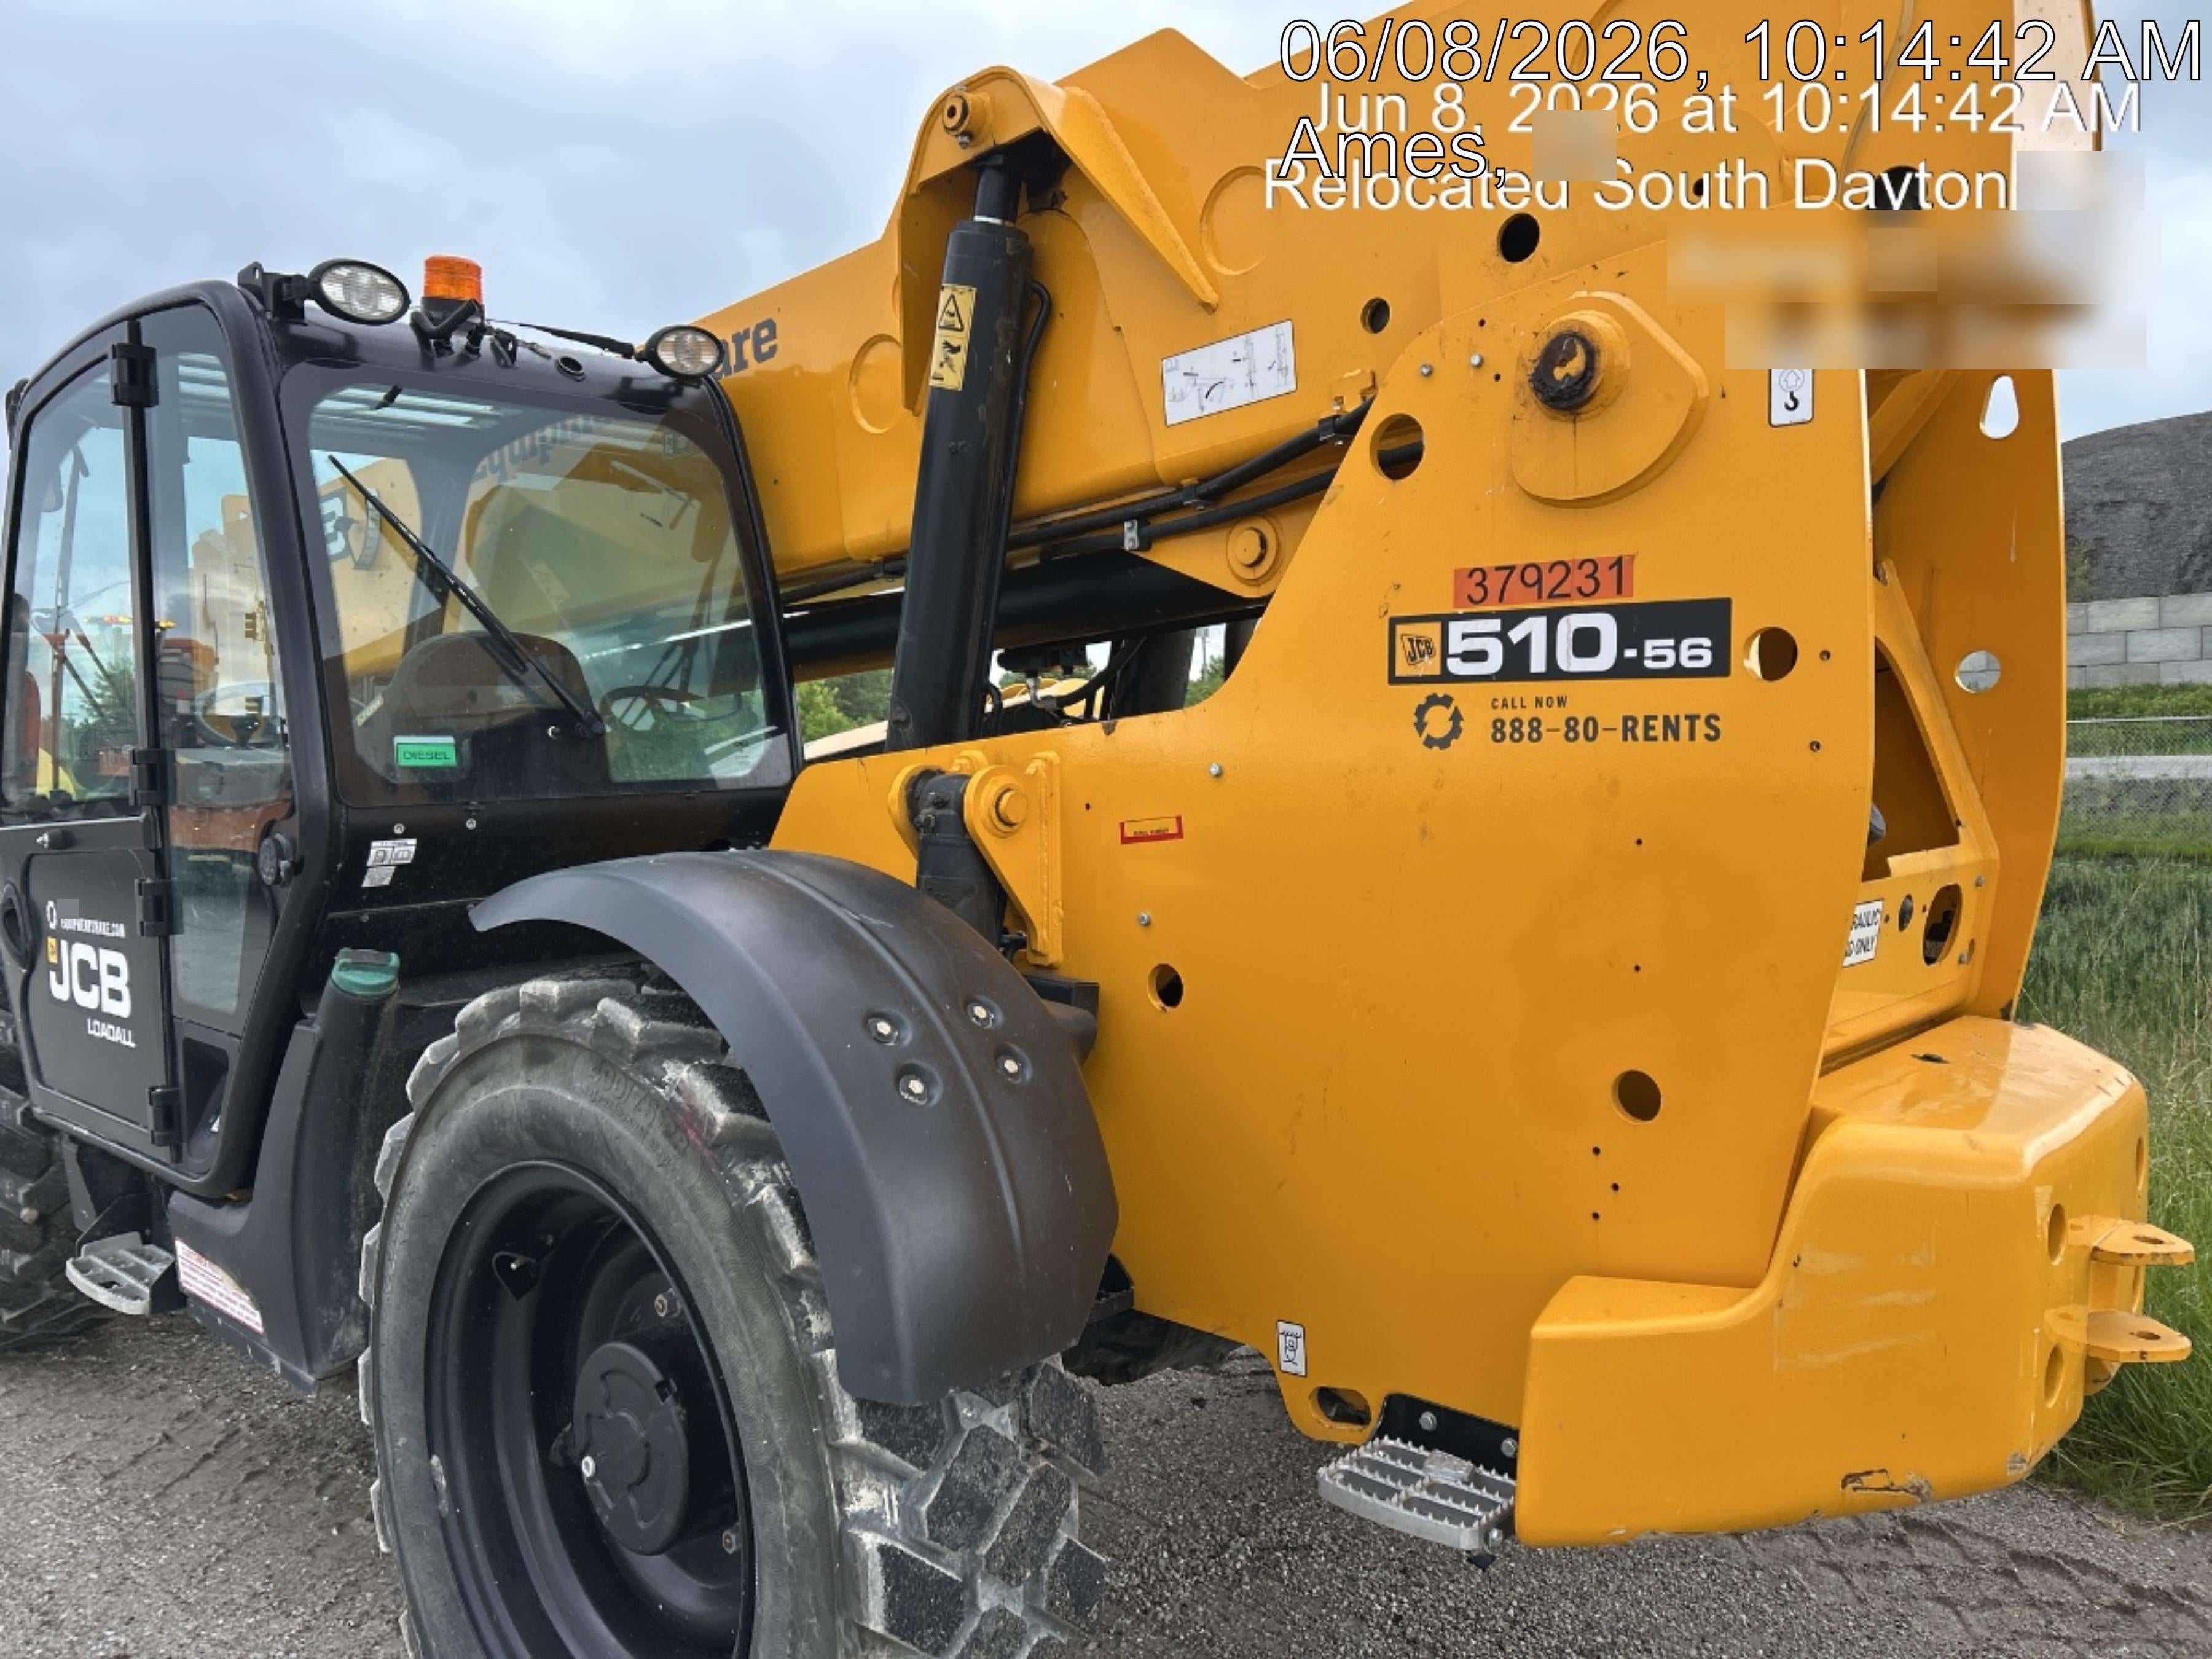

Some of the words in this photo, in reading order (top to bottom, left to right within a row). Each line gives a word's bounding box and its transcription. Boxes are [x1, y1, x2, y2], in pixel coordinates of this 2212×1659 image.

[1466, 555, 1624, 605] 379231
[1405, 636, 1435, 663] JCB
[1491, 697, 1527, 710] CALL
[1534, 695, 1568, 708] NOW
[1491, 713, 1722, 743] 888-80-RENTS
[403, 751, 451, 761] DIESEL
[49, 939, 132, 1019] JCB
[86, 1017, 136, 1048] LOADALL
